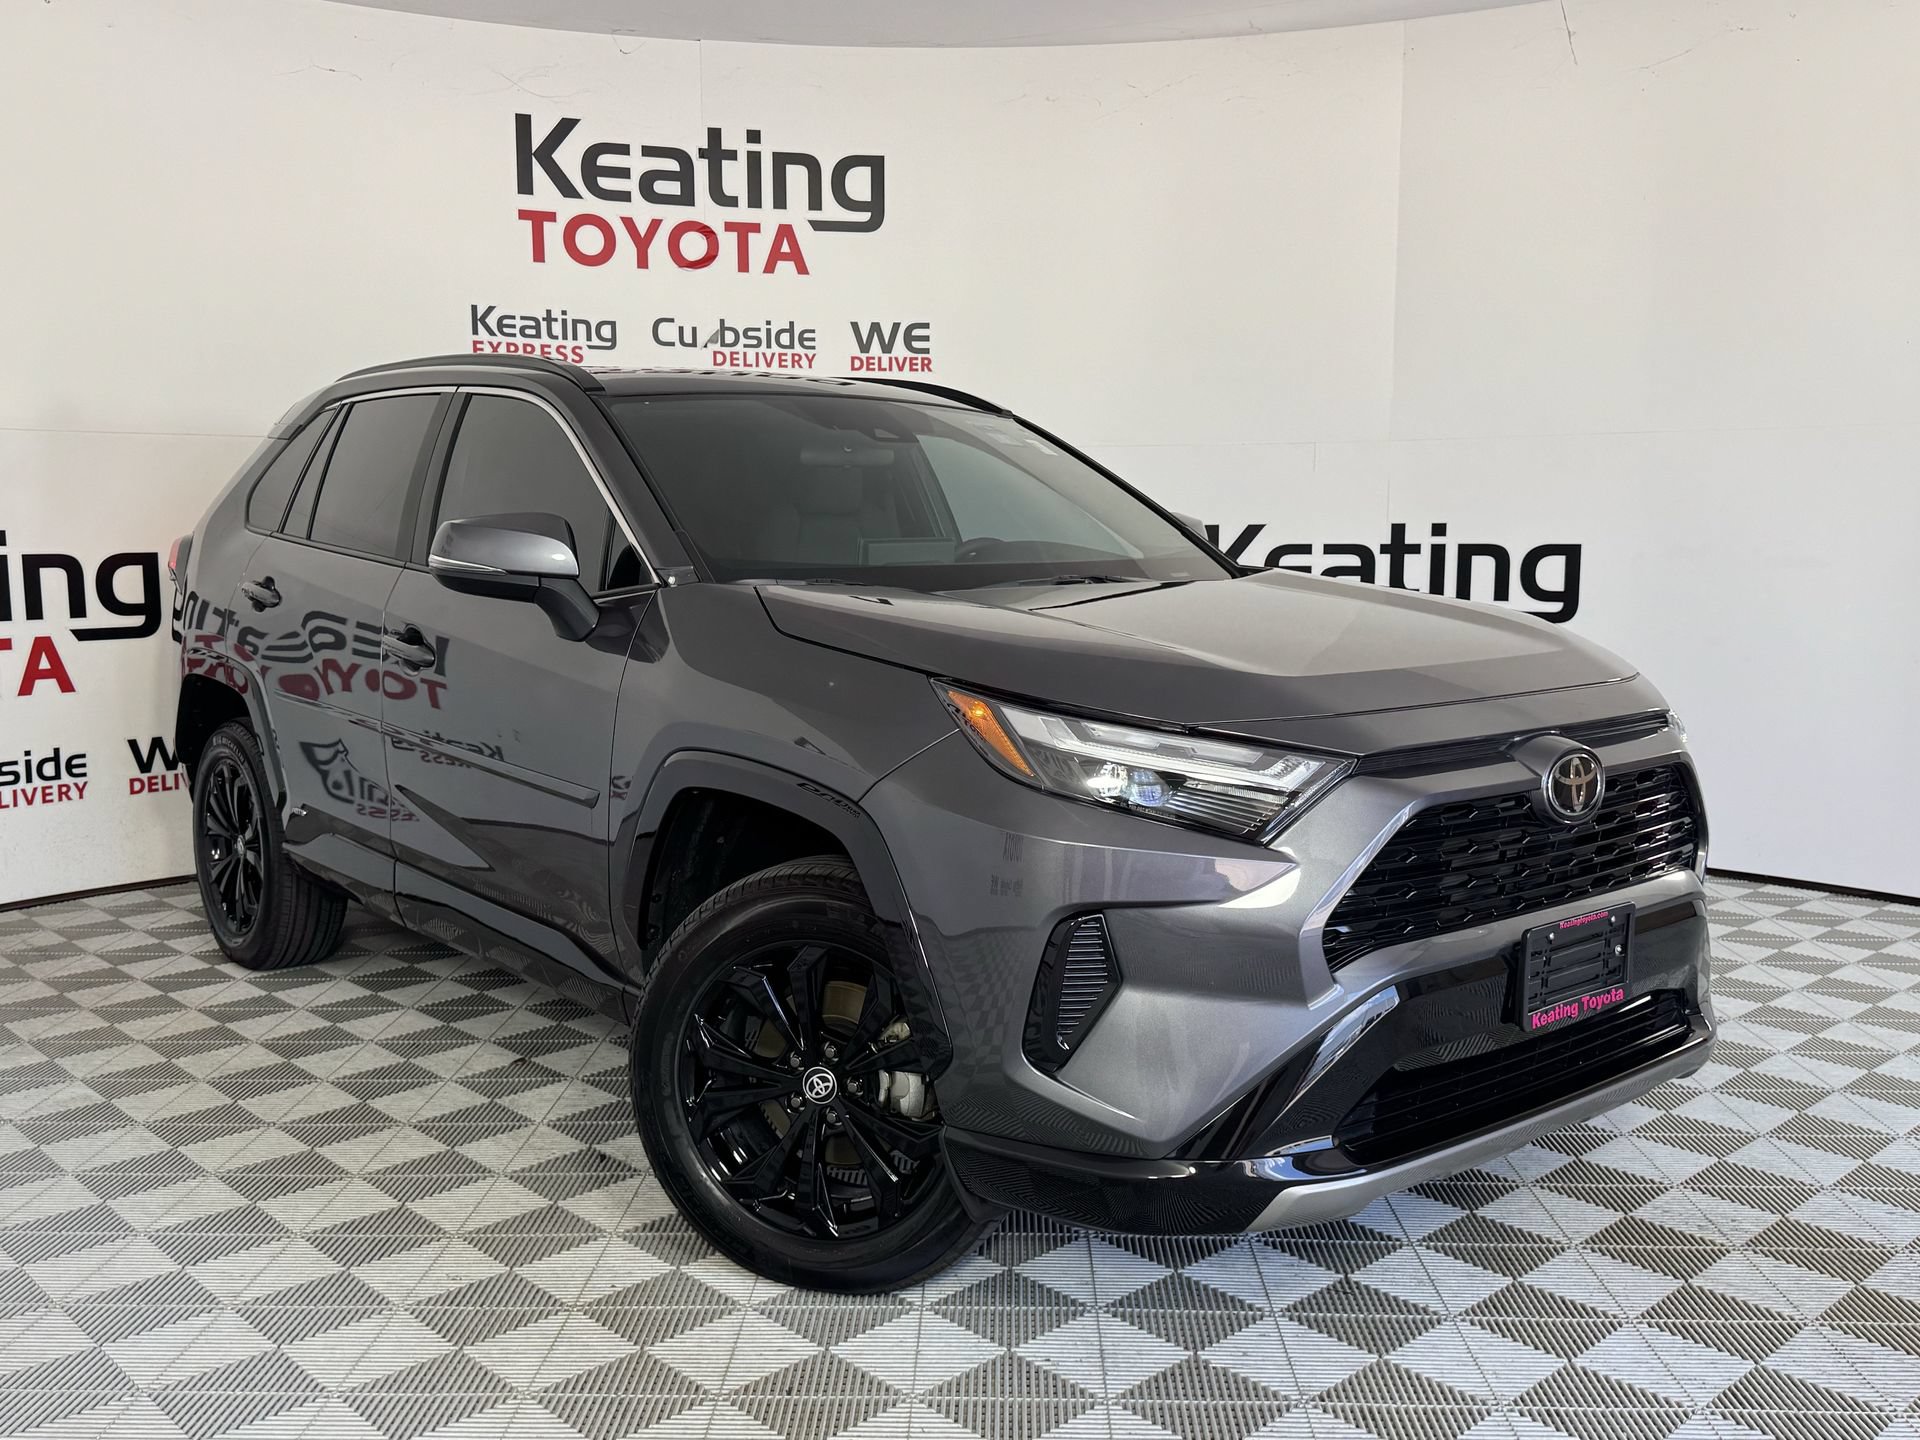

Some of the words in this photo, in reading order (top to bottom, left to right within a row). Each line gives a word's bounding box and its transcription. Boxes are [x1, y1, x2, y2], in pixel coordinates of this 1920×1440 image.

[515, 113, 885, 233] Keating
[517, 208, 811, 276] TOYOTA
[470, 304, 617, 351] Keating
[652, 317, 816, 350] Cubside
[850, 321, 931, 355] WE
[712, 350, 817, 369] DELIVERY
[850, 355, 933, 373] DELIVER
[1531, 1002, 1579, 1030] Keating
[1581, 987, 1624, 1011] Toyota
